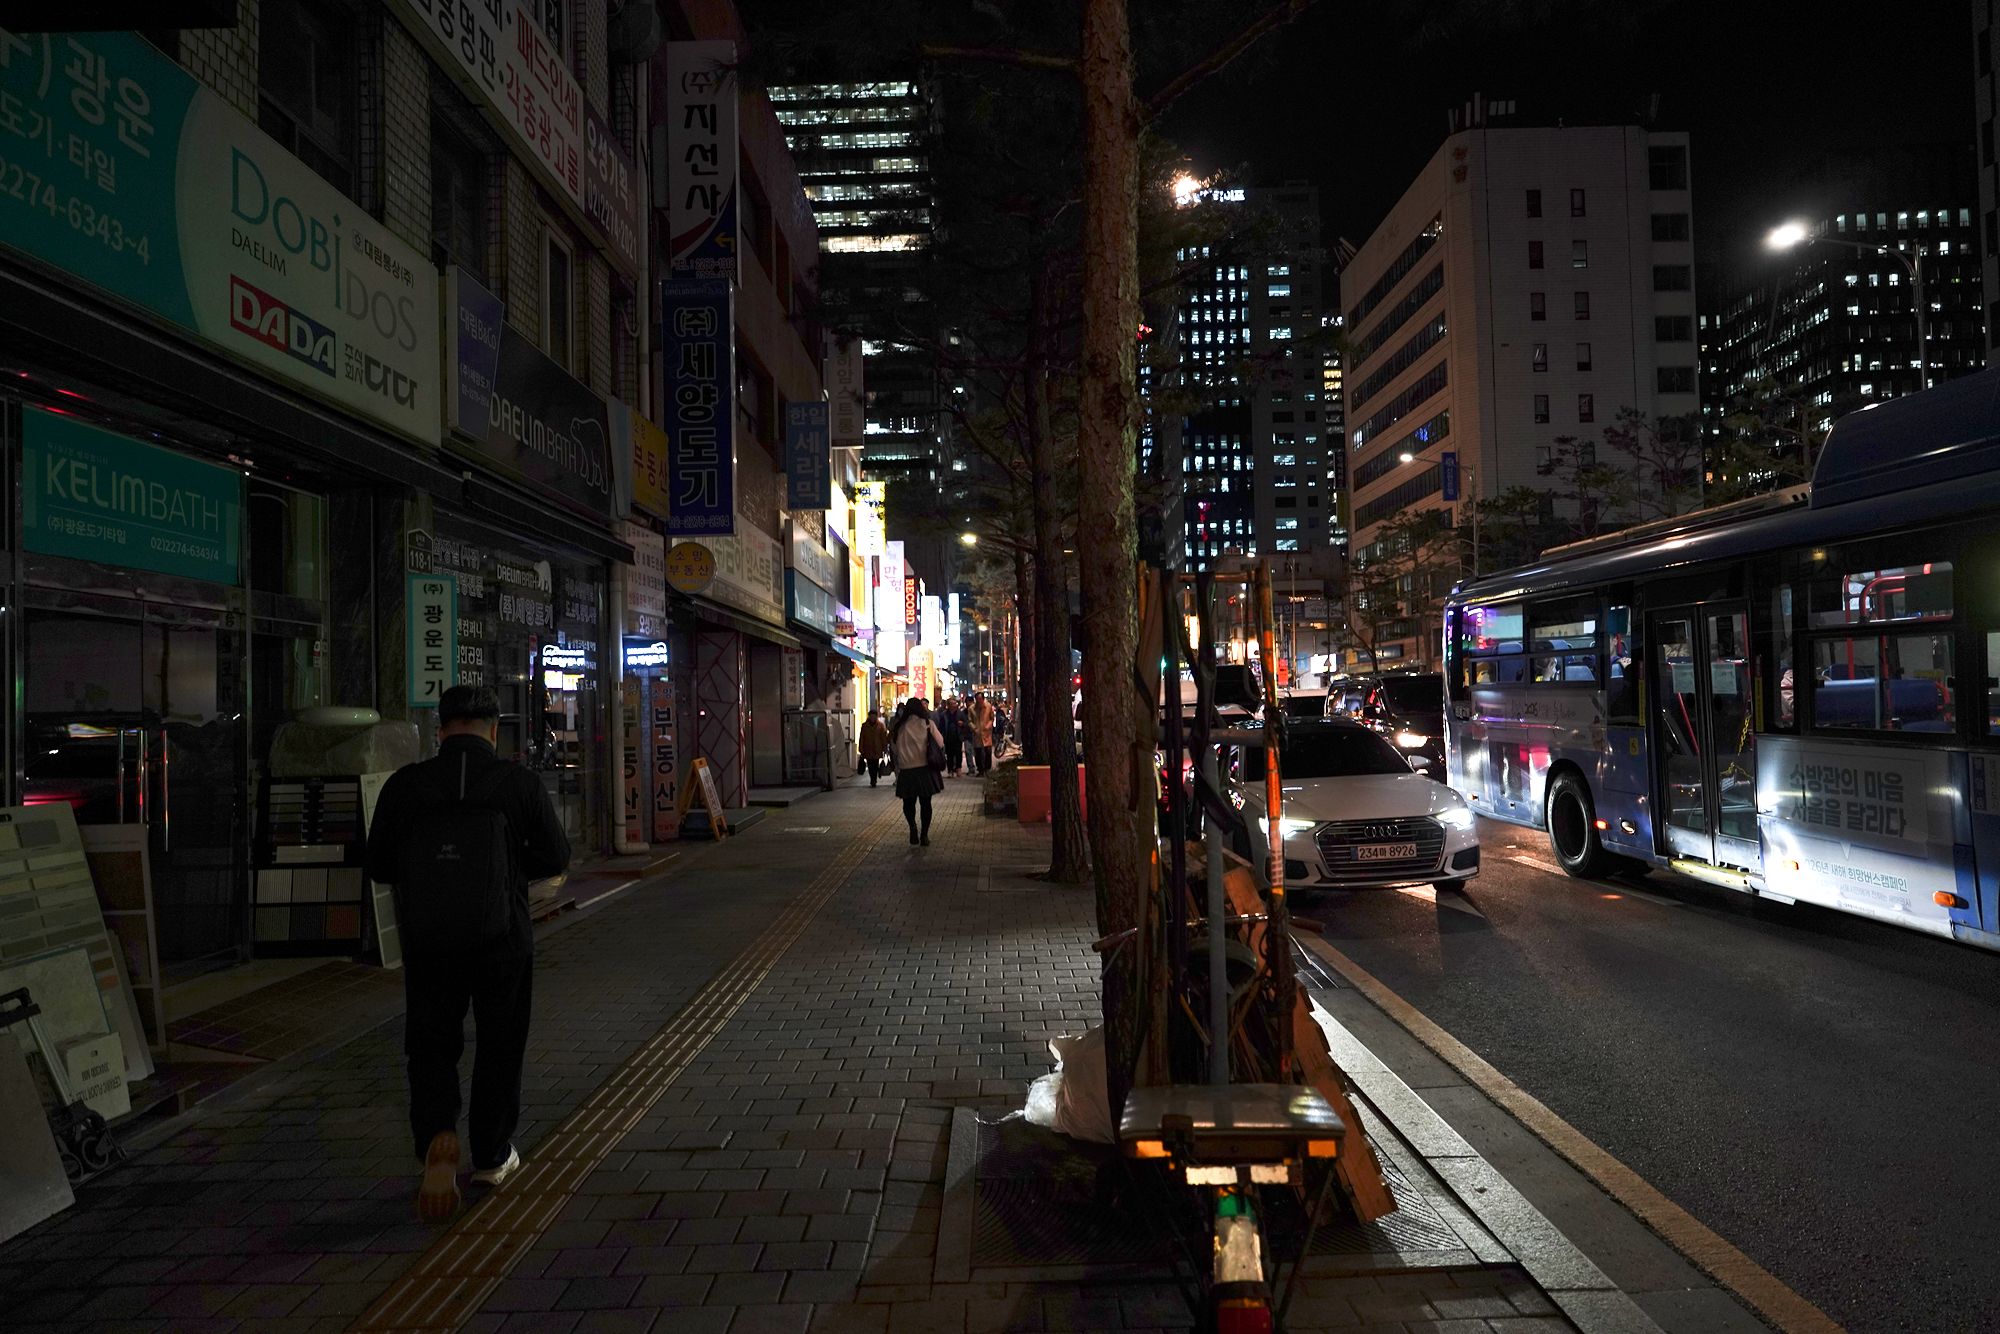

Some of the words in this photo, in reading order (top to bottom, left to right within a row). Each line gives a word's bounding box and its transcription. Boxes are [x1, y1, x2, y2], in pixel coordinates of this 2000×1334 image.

[232, 228, 286, 276] DAELIM
[232, 281, 336, 372] DADA
[790, 406, 826, 426] 한일
[634, 440, 667, 494] 부동산
[410, 551, 432, 569] 118-1
[906, 578, 915, 625] RECORD
[653, 707, 675, 812] 부동산
[1790, 764, 1859, 797] 소방관의
[1864, 770, 1904, 803] 마음
[1791, 797, 1842, 828] 서울을
[1847, 801, 1907, 838] 달리다
[1389, 845, 1415, 857] 8926
[1848, 867, 1908, 892] 희망버스캠페인
